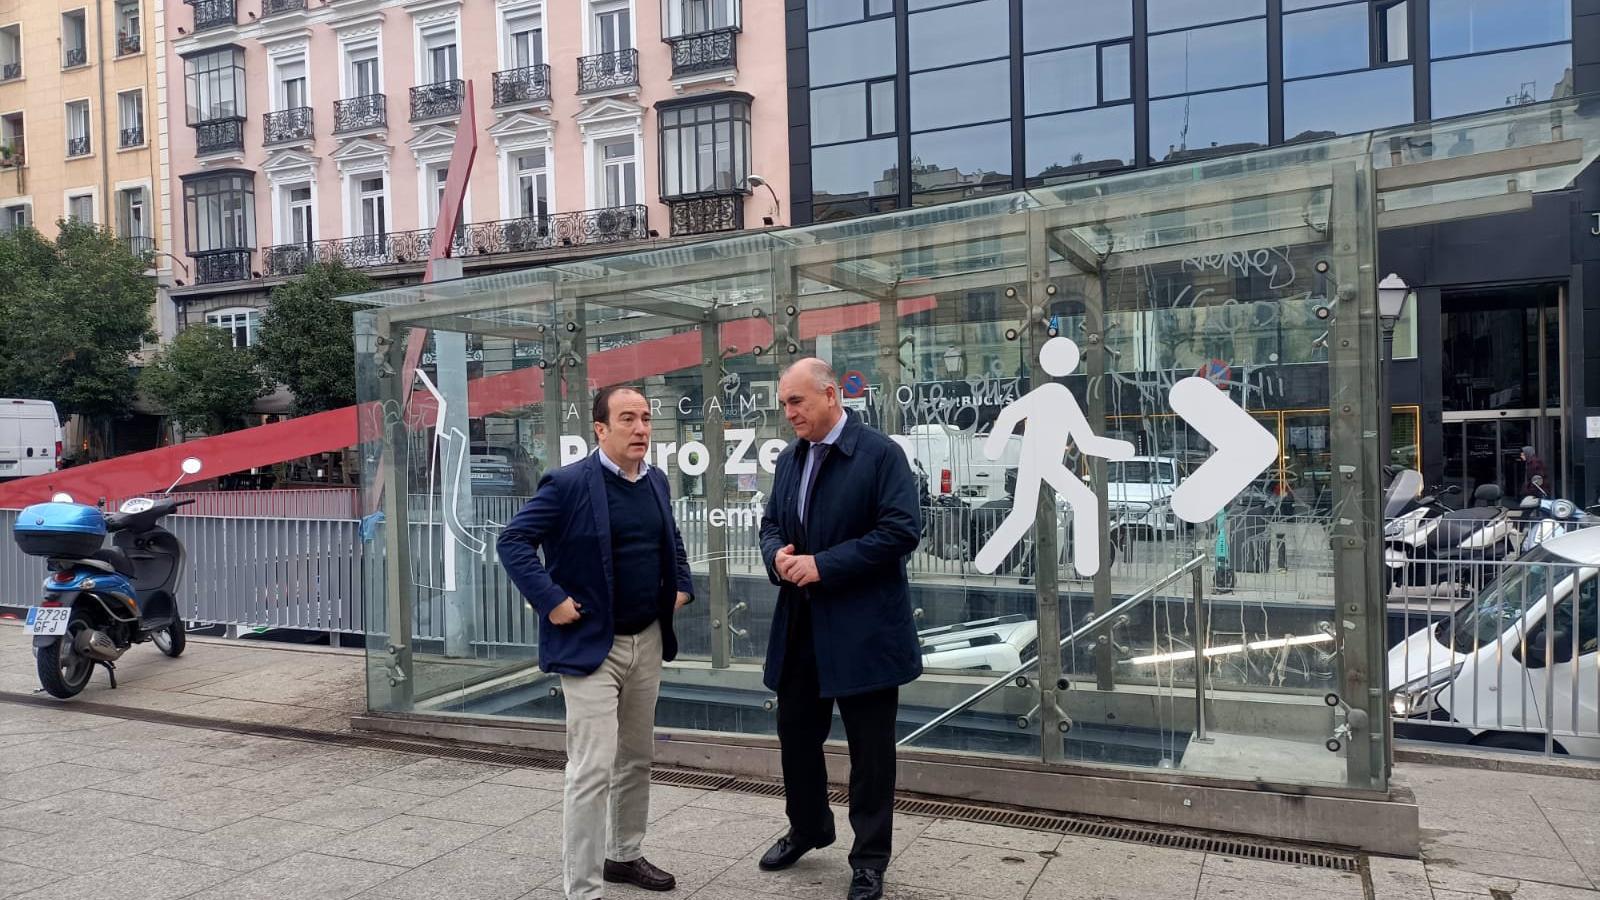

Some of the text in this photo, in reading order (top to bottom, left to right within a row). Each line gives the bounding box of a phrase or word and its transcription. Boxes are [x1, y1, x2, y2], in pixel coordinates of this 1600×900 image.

[566, 384, 913, 420] ARCAMITO
[920, 392, 1016, 408] SBUCKS
[559, 434, 710, 476] Pro
[36, 609, 68, 621] 2728
[33, 621, 58, 633] GFJ
